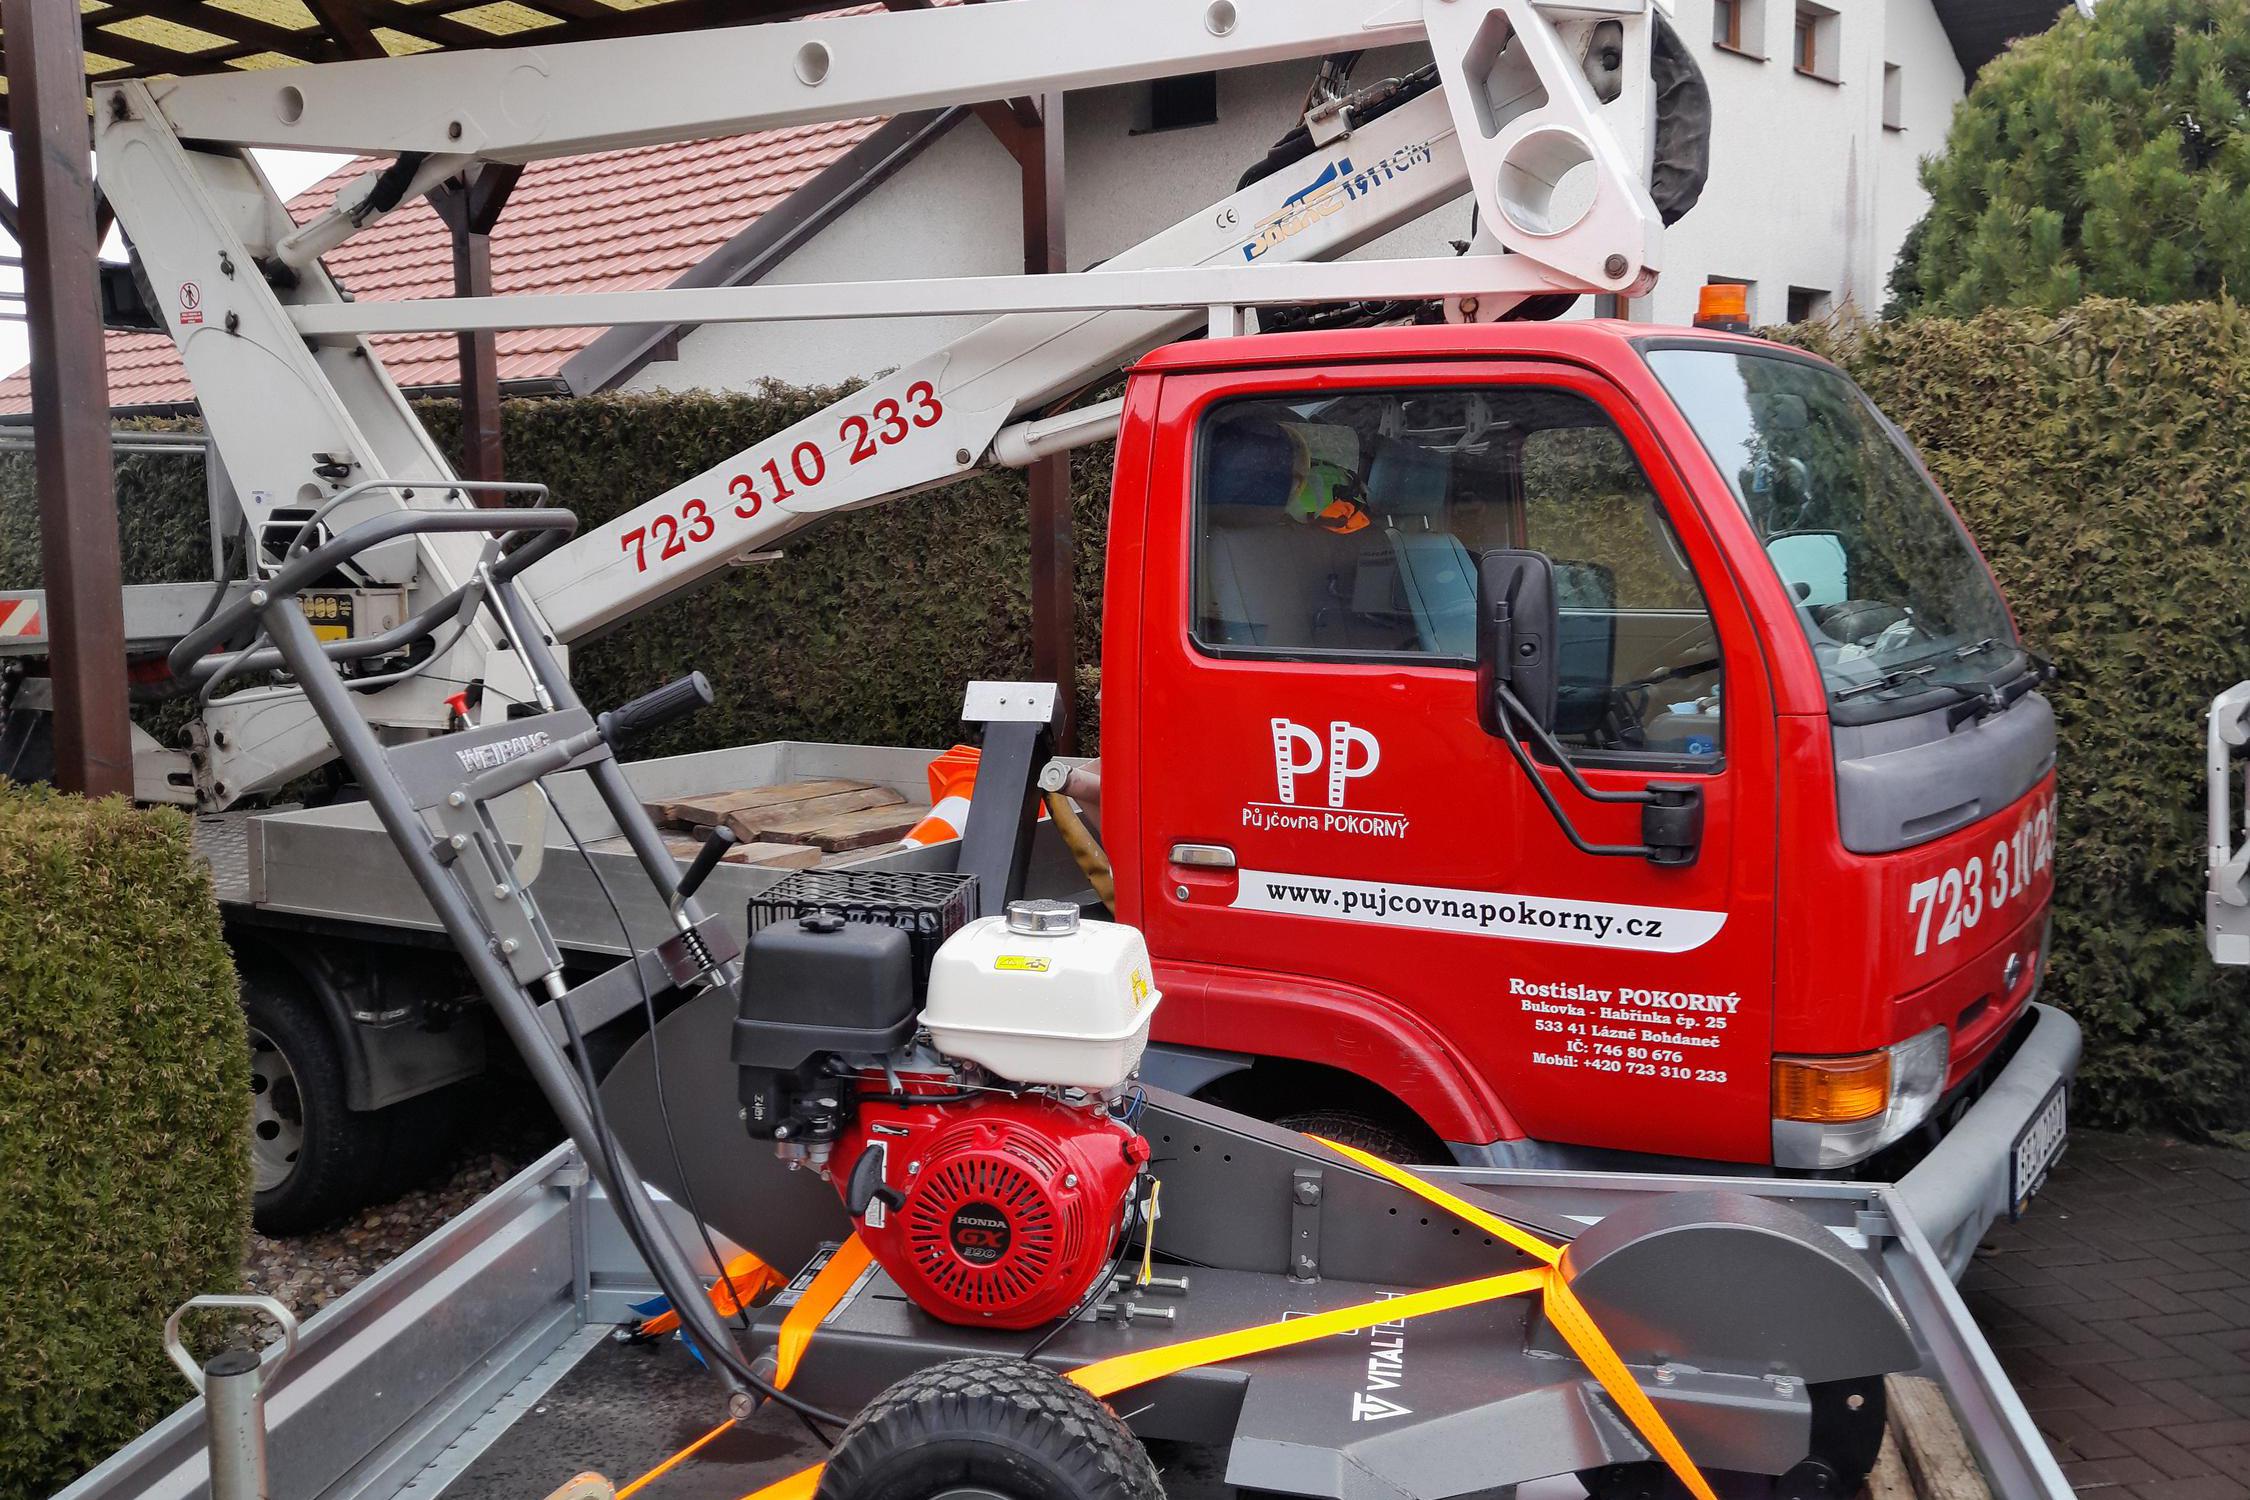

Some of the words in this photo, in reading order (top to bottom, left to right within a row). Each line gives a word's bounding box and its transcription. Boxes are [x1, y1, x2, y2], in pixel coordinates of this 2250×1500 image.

[621, 498, 716, 573] 723
[729, 441, 826, 519] 310
[840, 380, 943, 465] 233
[1270, 718, 1380, 808] PP
[1324, 813, 1409, 839] POKORNÝ
[1266, 881, 1663, 940] www.pujcovnapokorny.cz
[1908, 856, 1984, 957] 723
[1509, 978, 1612, 1003] Rostislav
[1619, 987, 1741, 1014] POKORNÝ
[1521, 999, 1586, 1017] Bukovka
[1600, 1006, 1672, 1025] Habřinka
[1676, 1014, 1700, 1030] čp.
[1705, 1016, 1727, 1029] 25
[1535, 1019, 1563, 1033] 533
[1567, 1022, 1586, 1035] 41
[1591, 1024, 1637, 1040] Lázně
[1641, 1029, 1721, 1048] Bohdaneč
[1566, 1038, 1589, 1053] IČ:
[1593, 1043, 1623, 1057] 746
[1627, 1046, 1648, 1059] 80
[1651, 1049, 1684, 1063] 676
[1532, 1052, 1579, 1068] Mobil:
[1583, 1058, 1622, 1072] +420
[1625, 1062, 1656, 1076] 723
[1660, 1066, 1692, 1080] 310
[1695, 1069, 1728, 1083] 233
[957, 1216, 1008, 1228] HONDA
[957, 1229, 1003, 1247] GX
